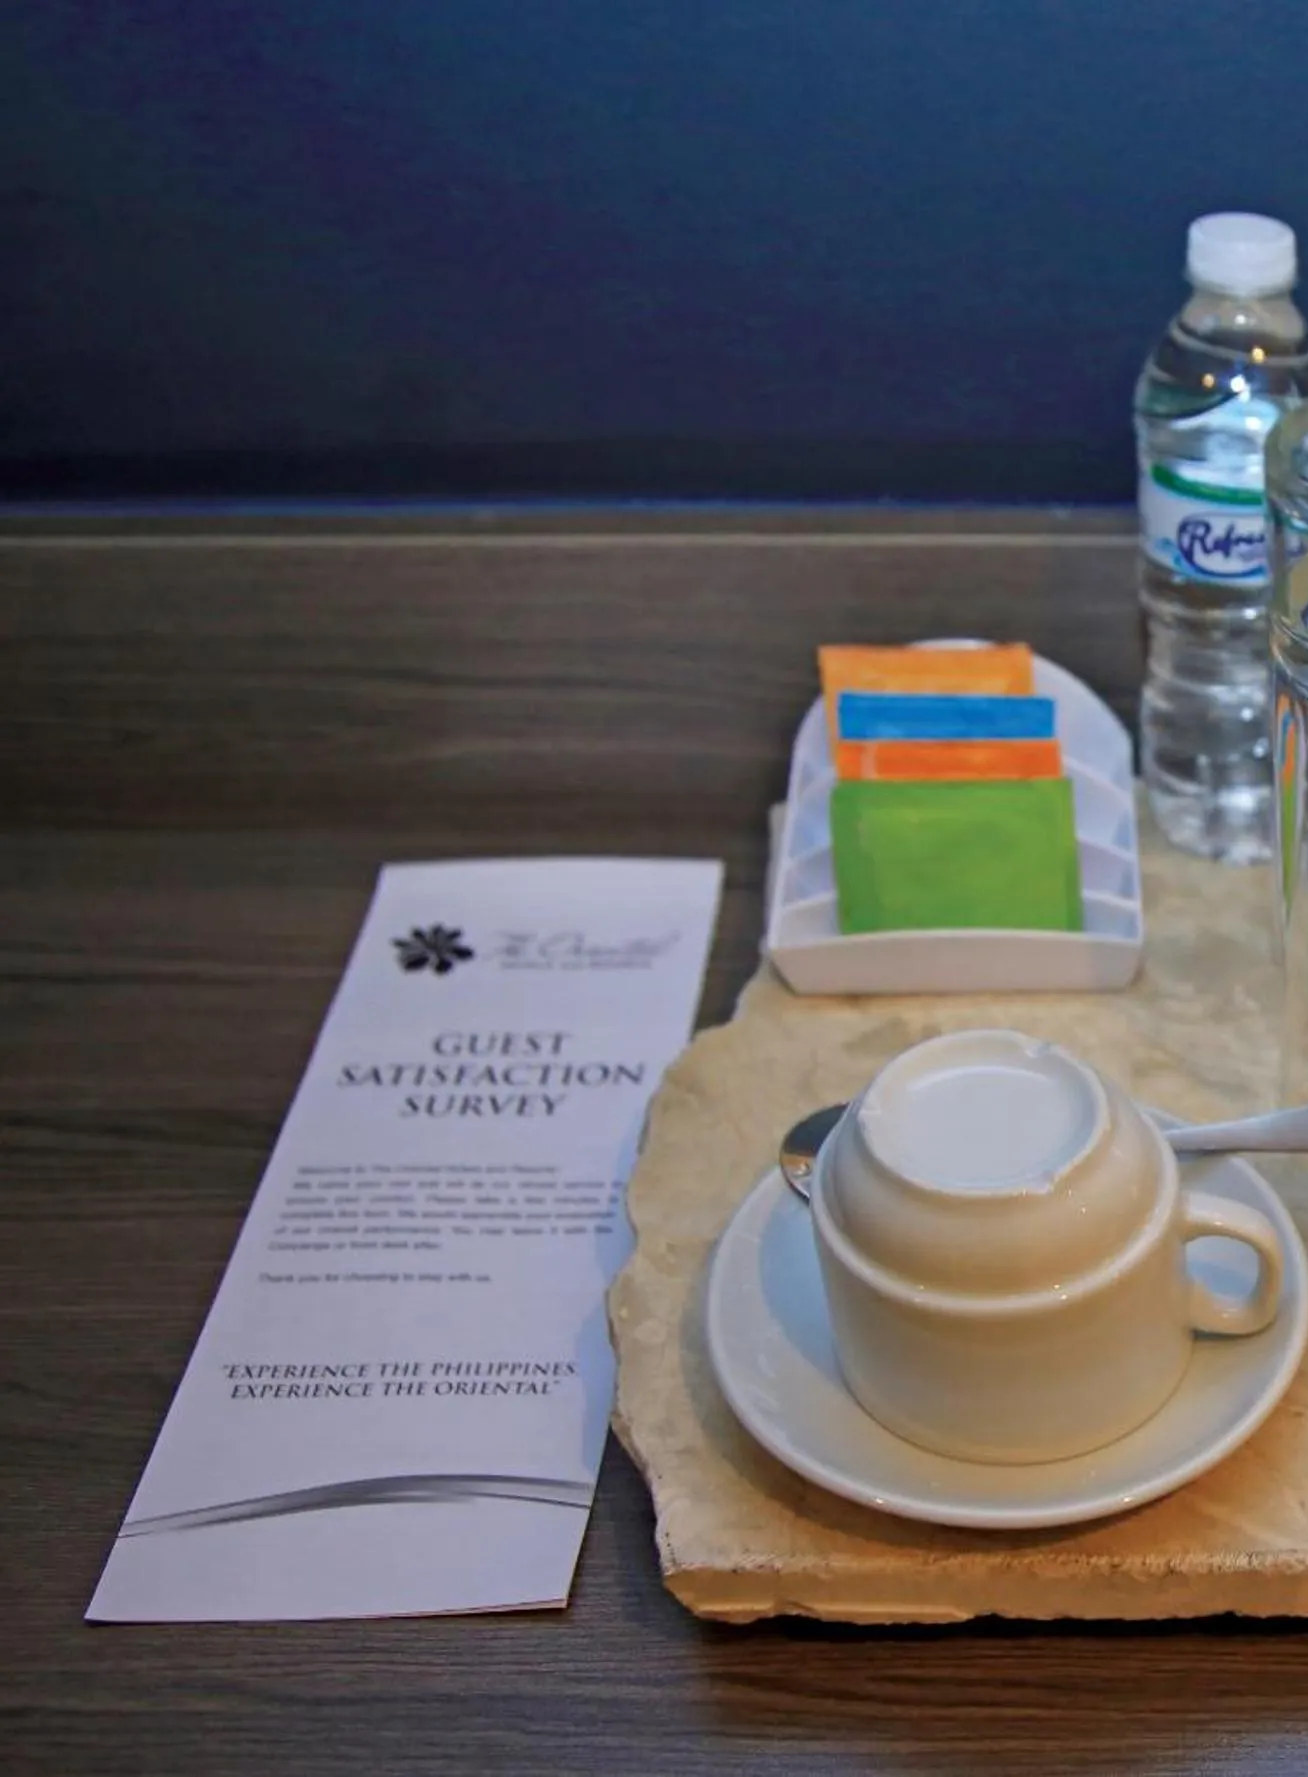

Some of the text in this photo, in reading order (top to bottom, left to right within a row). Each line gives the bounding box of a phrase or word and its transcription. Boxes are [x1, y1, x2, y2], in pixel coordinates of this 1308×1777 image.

[433, 1032, 572, 1057] GUEST
[338, 1062, 646, 1088] SATISFACTION
[399, 1095, 567, 1118] SURVEY
[378, 1362, 425, 1377] THE
[230, 1383, 374, 1399] EXPERIENCE
[383, 1381, 429, 1396] THE
